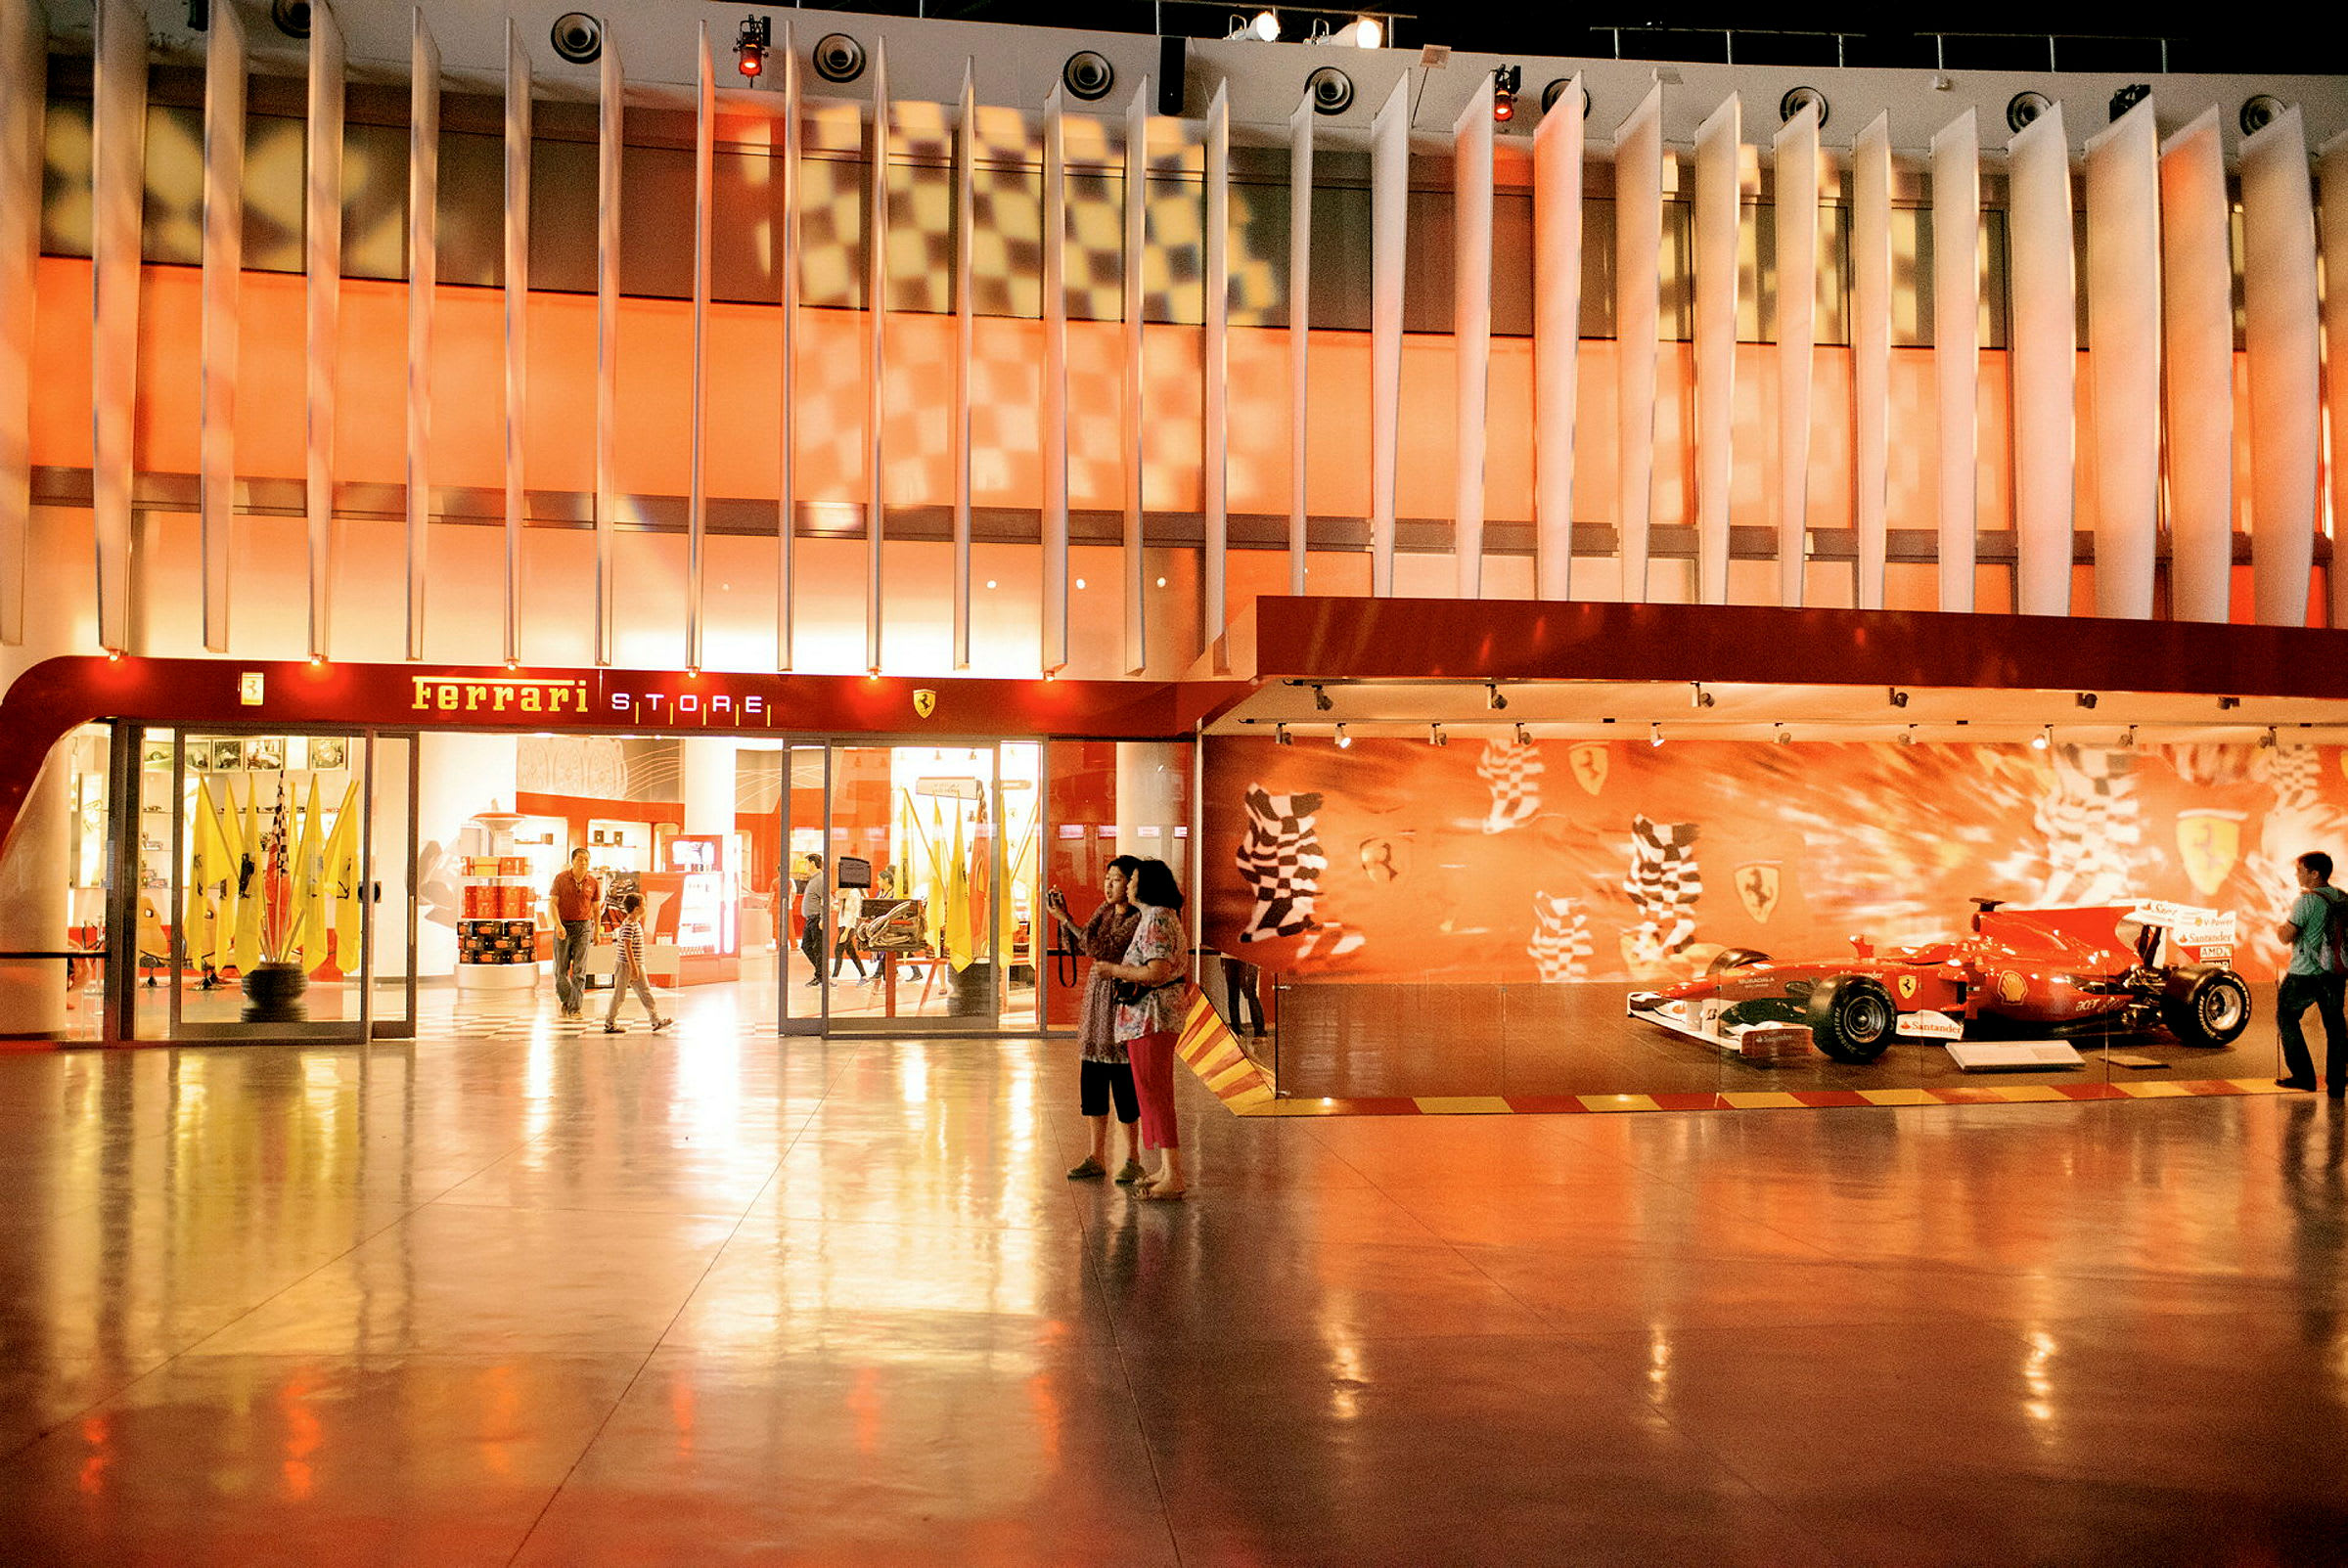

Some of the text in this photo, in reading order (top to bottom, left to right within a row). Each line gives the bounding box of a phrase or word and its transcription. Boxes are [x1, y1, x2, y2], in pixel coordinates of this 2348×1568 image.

[412, 676, 763, 713] Ferrari STORE
[2190, 931, 2232, 943] Santander
[2076, 999, 2100, 1010] acer
[1912, 1020, 1962, 1033] Santander
